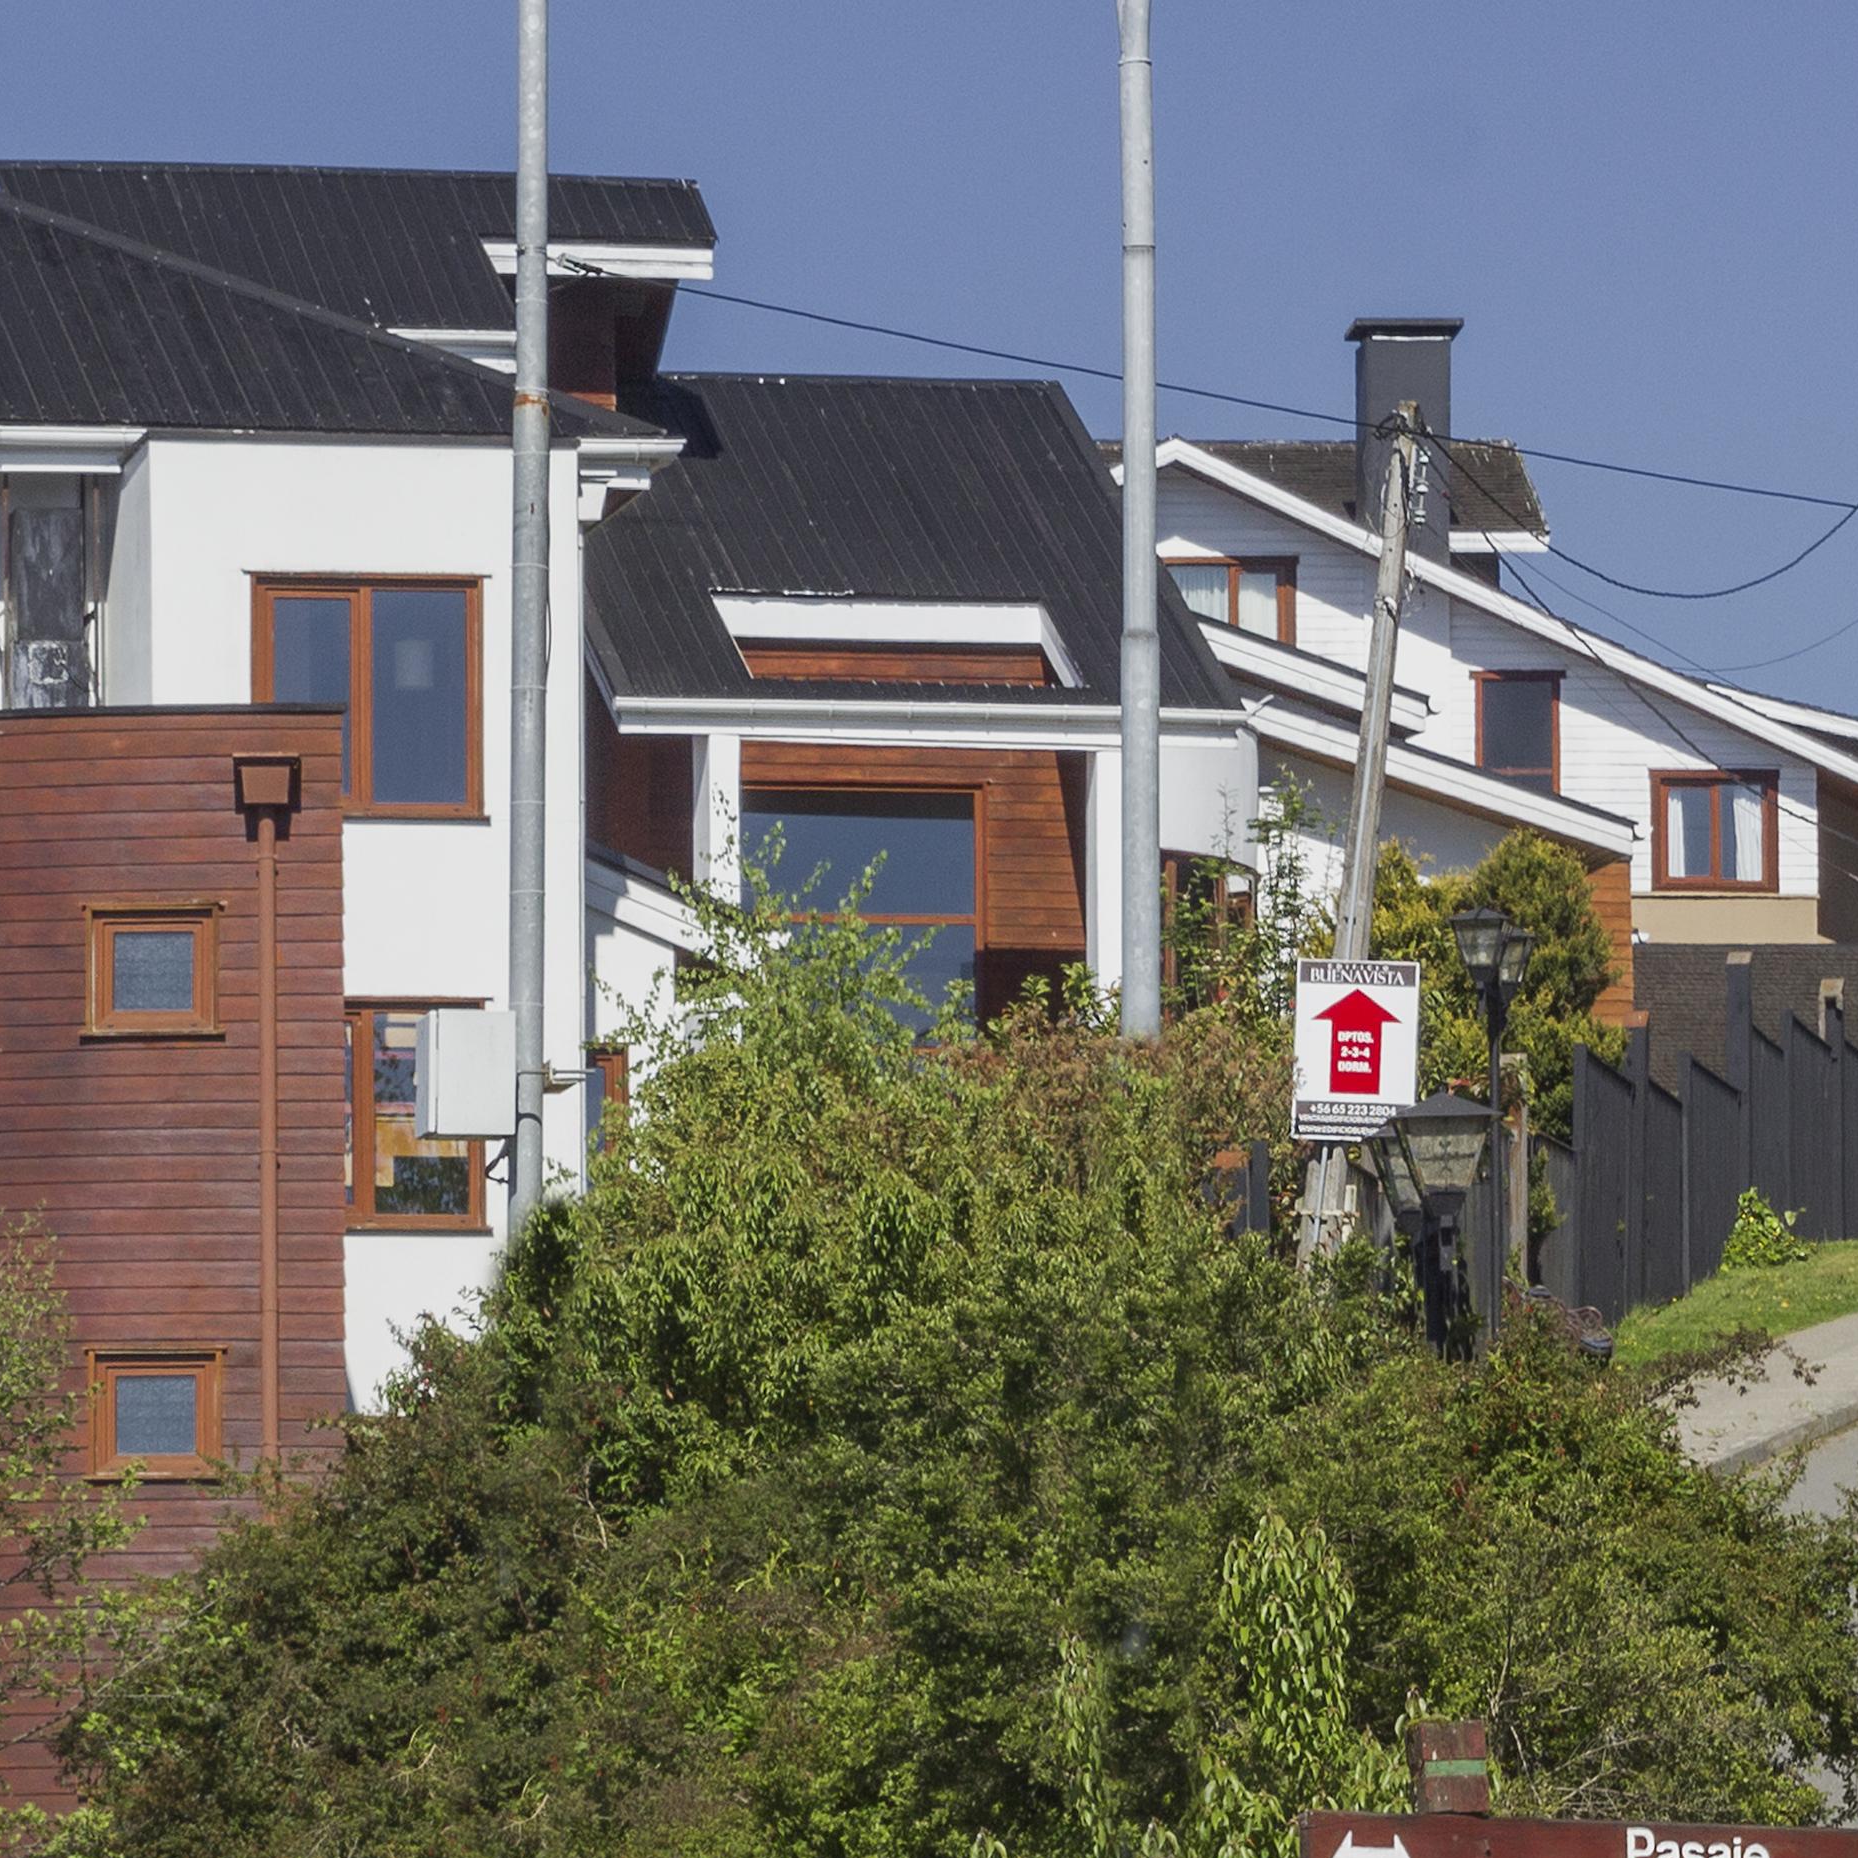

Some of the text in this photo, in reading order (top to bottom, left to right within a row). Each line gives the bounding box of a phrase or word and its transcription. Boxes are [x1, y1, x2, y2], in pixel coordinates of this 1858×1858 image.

[1310, 967, 1405, 986] BUENAVISTA
[1341, 1046, 1370, 1058] 2-3-4
[1310, 1103, 1331, 1114] +56
[1332, 1104, 1346, 1114] 65
[1347, 1105, 1367, 1115] 223
